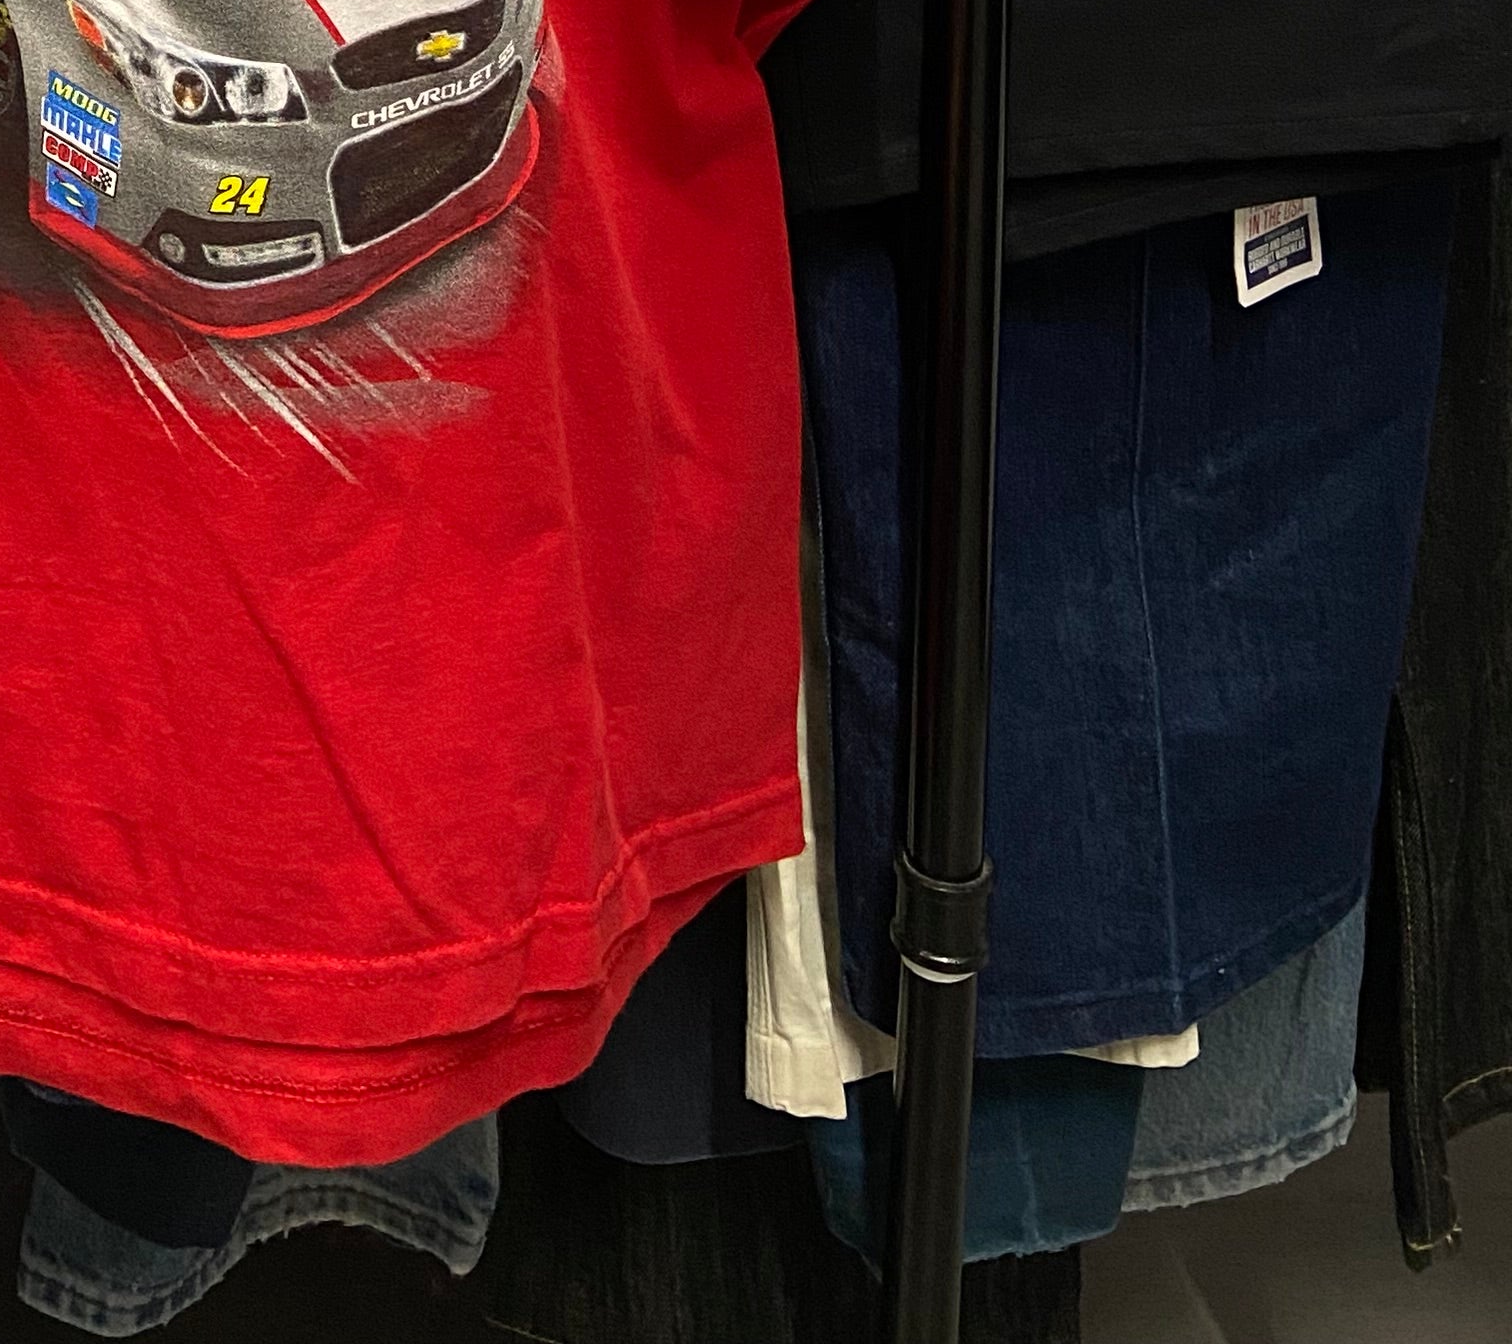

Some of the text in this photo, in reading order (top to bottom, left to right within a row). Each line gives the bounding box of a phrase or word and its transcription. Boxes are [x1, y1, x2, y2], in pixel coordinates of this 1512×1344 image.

[51, 77, 118, 126] MOOG
[350, 61, 494, 130] CHEVROLET
[45, 135, 99, 178] COMP
[209, 174, 272, 216] 24
